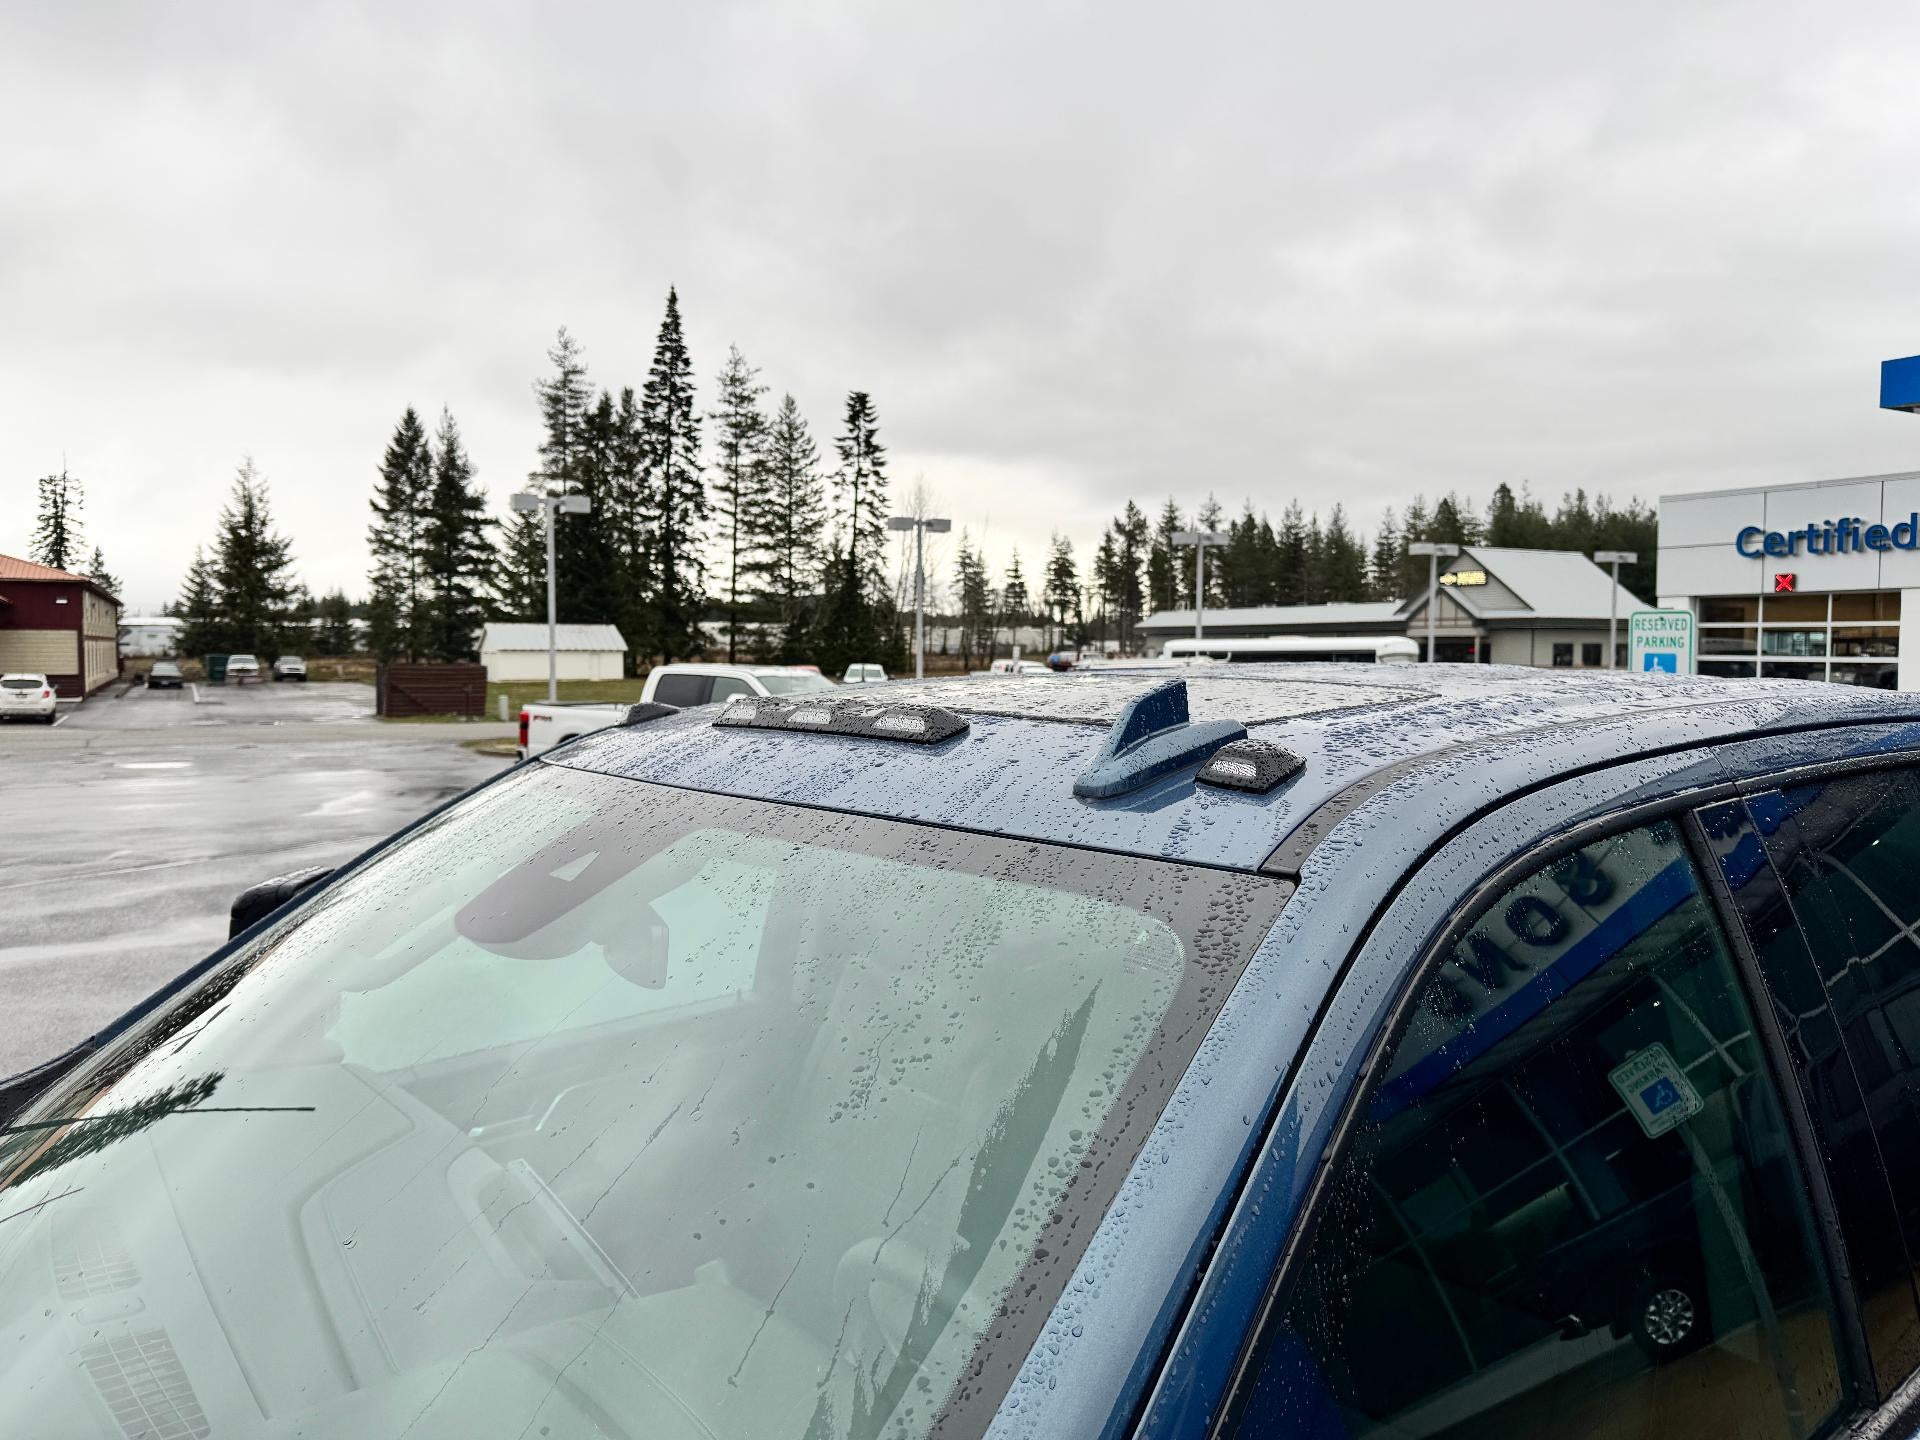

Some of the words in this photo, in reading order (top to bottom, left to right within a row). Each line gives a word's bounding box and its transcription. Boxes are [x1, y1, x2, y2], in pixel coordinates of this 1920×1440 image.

[1736, 512, 1919, 559] Certified
[1634, 618, 1687, 631] RESERVED
[1637, 636, 1685, 648] PARKING
